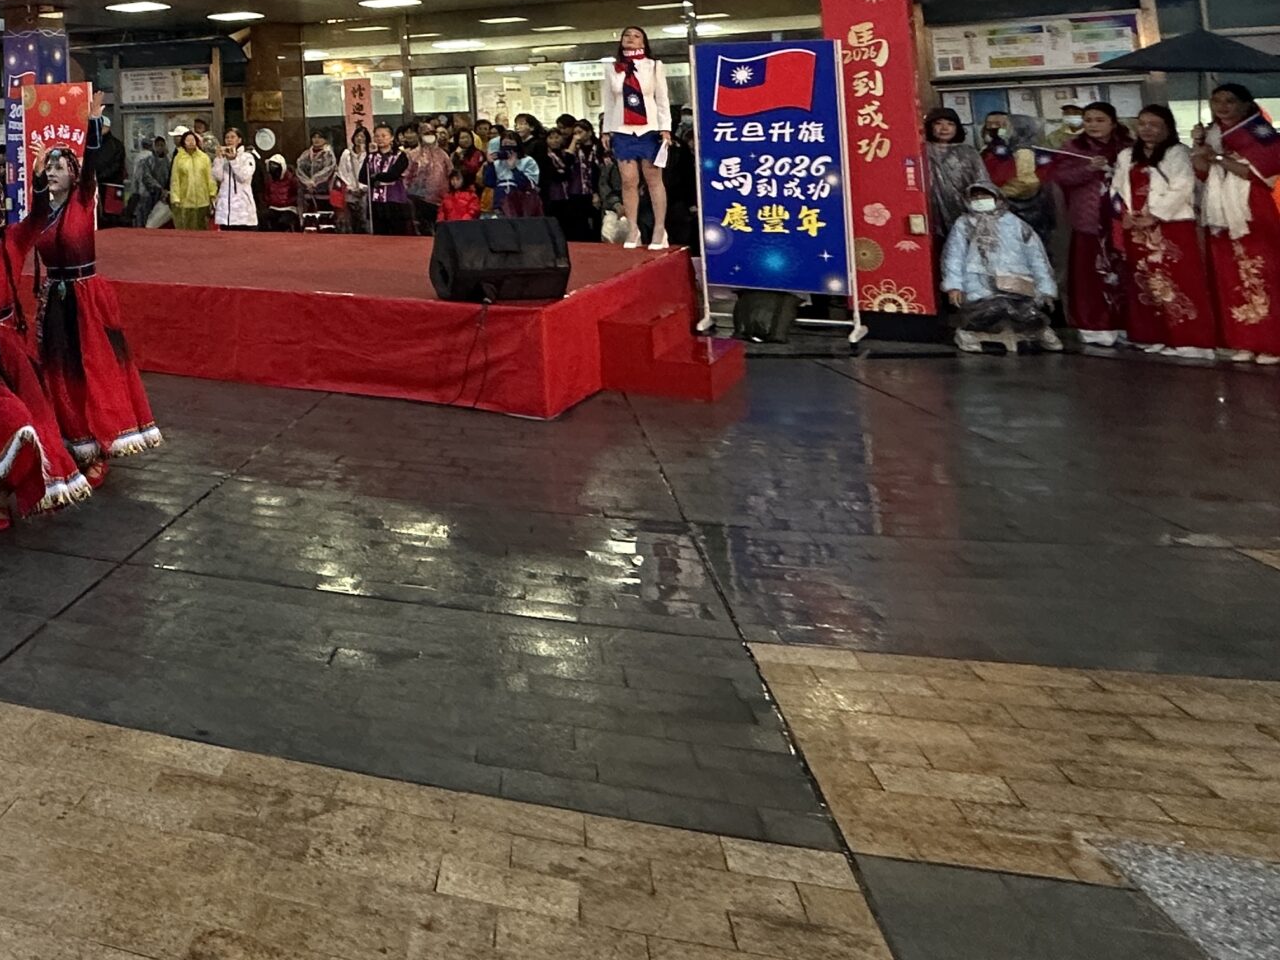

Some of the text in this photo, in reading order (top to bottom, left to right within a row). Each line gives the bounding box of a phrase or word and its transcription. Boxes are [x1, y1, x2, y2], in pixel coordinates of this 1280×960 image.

[842, 47, 877, 65] 2026
[847, 21, 891, 163] 馬到成功
[713, 121, 825, 143] 元旦升旗
[754, 154, 833, 178] 2026
[720, 202, 827, 237] 慶豐年
